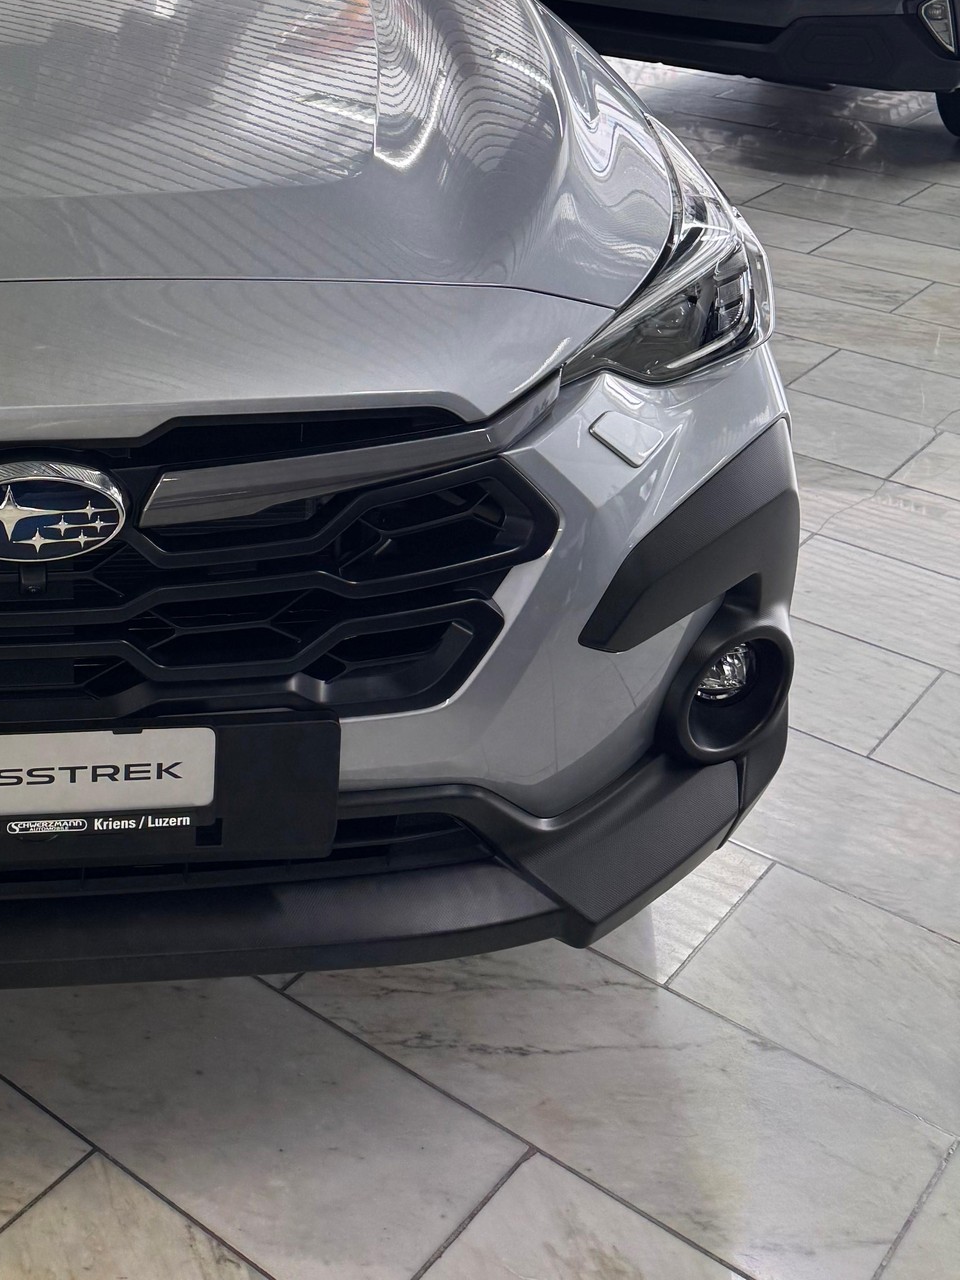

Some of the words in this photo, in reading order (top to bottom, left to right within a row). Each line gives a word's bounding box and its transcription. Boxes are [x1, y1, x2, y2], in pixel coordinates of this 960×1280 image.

[94, 818, 136, 830] Kriens
[139, 816, 145, 829] /
[148, 816, 190, 827] Luzern
